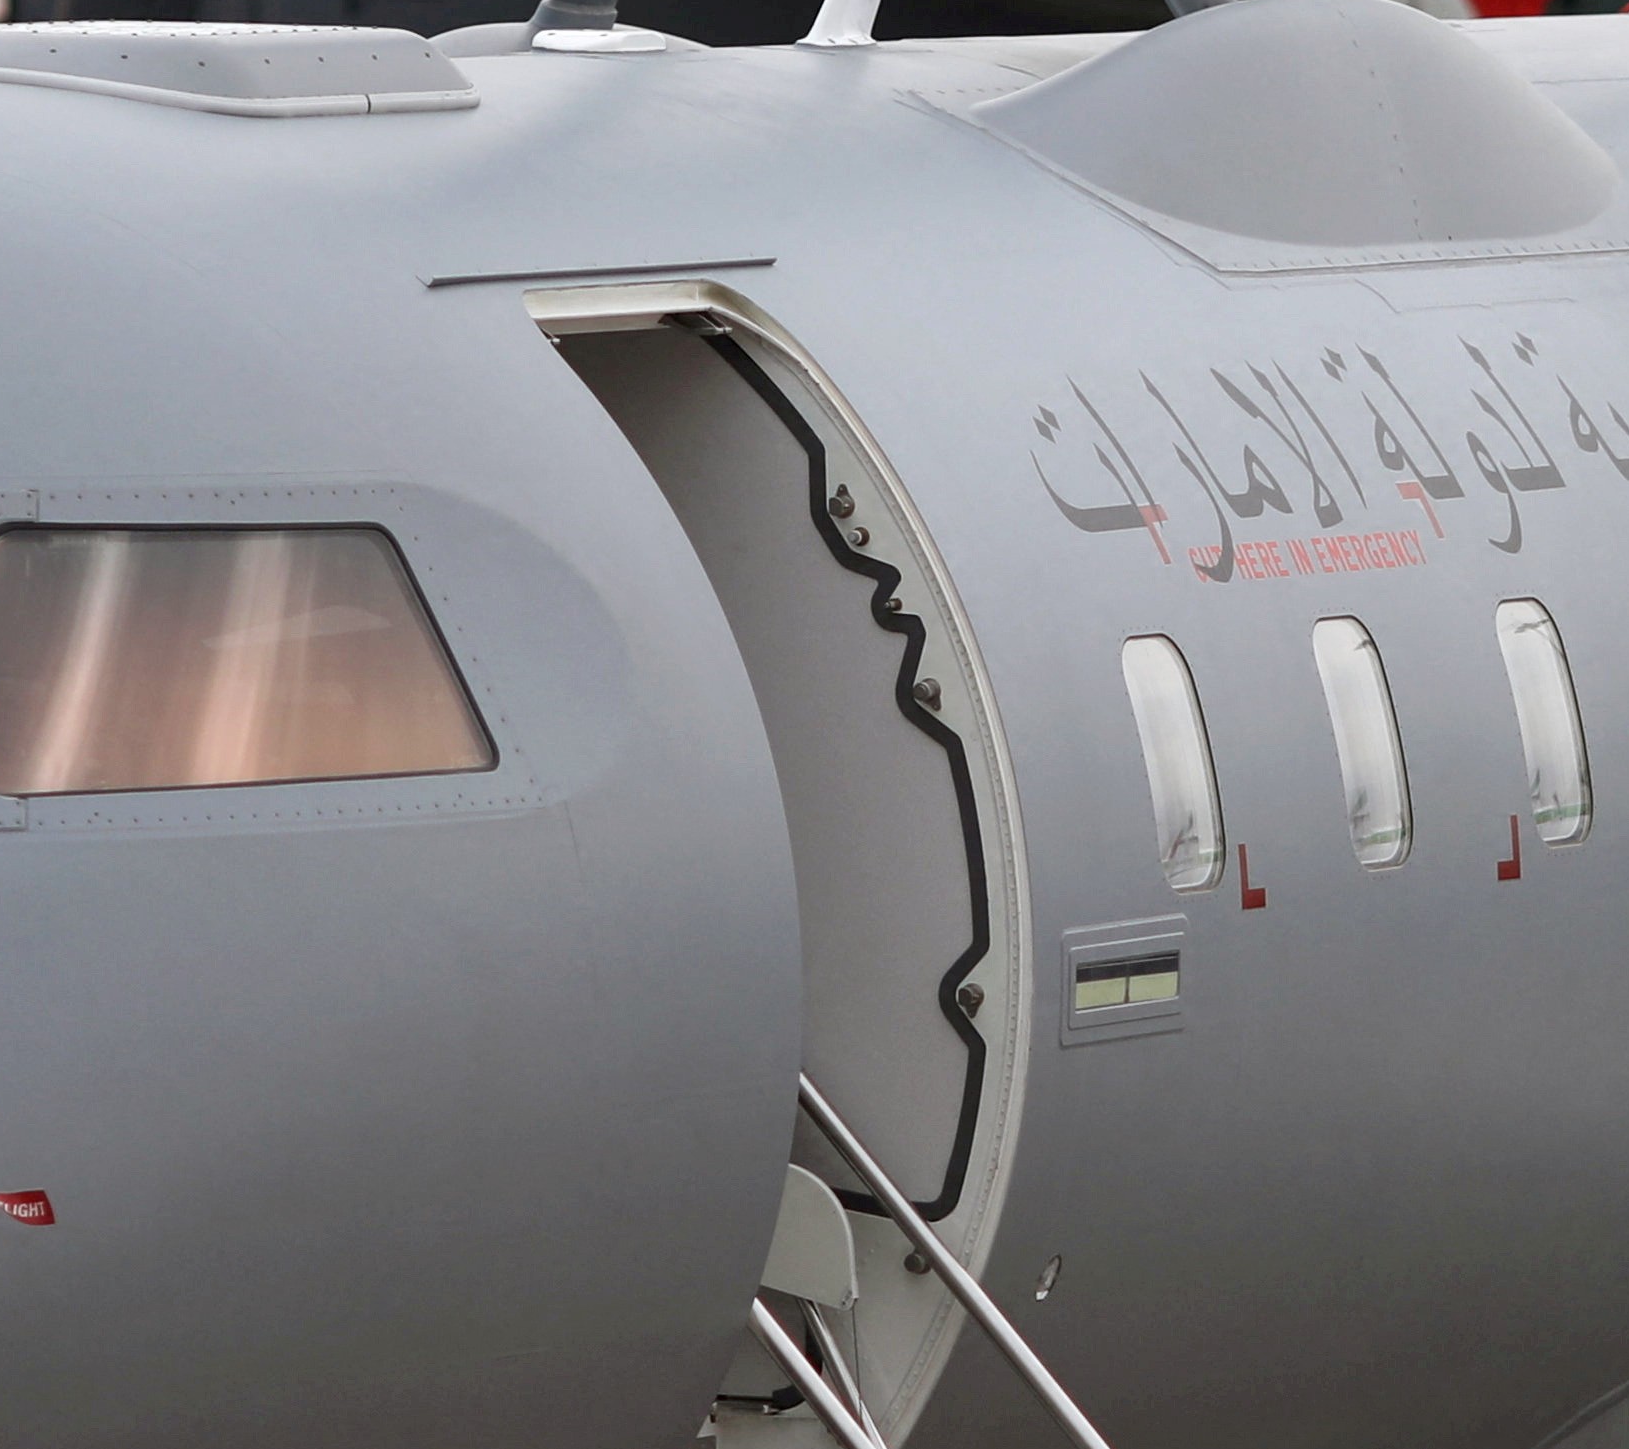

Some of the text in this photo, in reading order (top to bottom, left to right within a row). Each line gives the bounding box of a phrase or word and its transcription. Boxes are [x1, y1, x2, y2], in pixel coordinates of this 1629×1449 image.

[1234, 540, 1291, 580] HERE
[1285, 538, 1316, 576] IN
[1311, 529, 1428, 574] EMERGENCY
